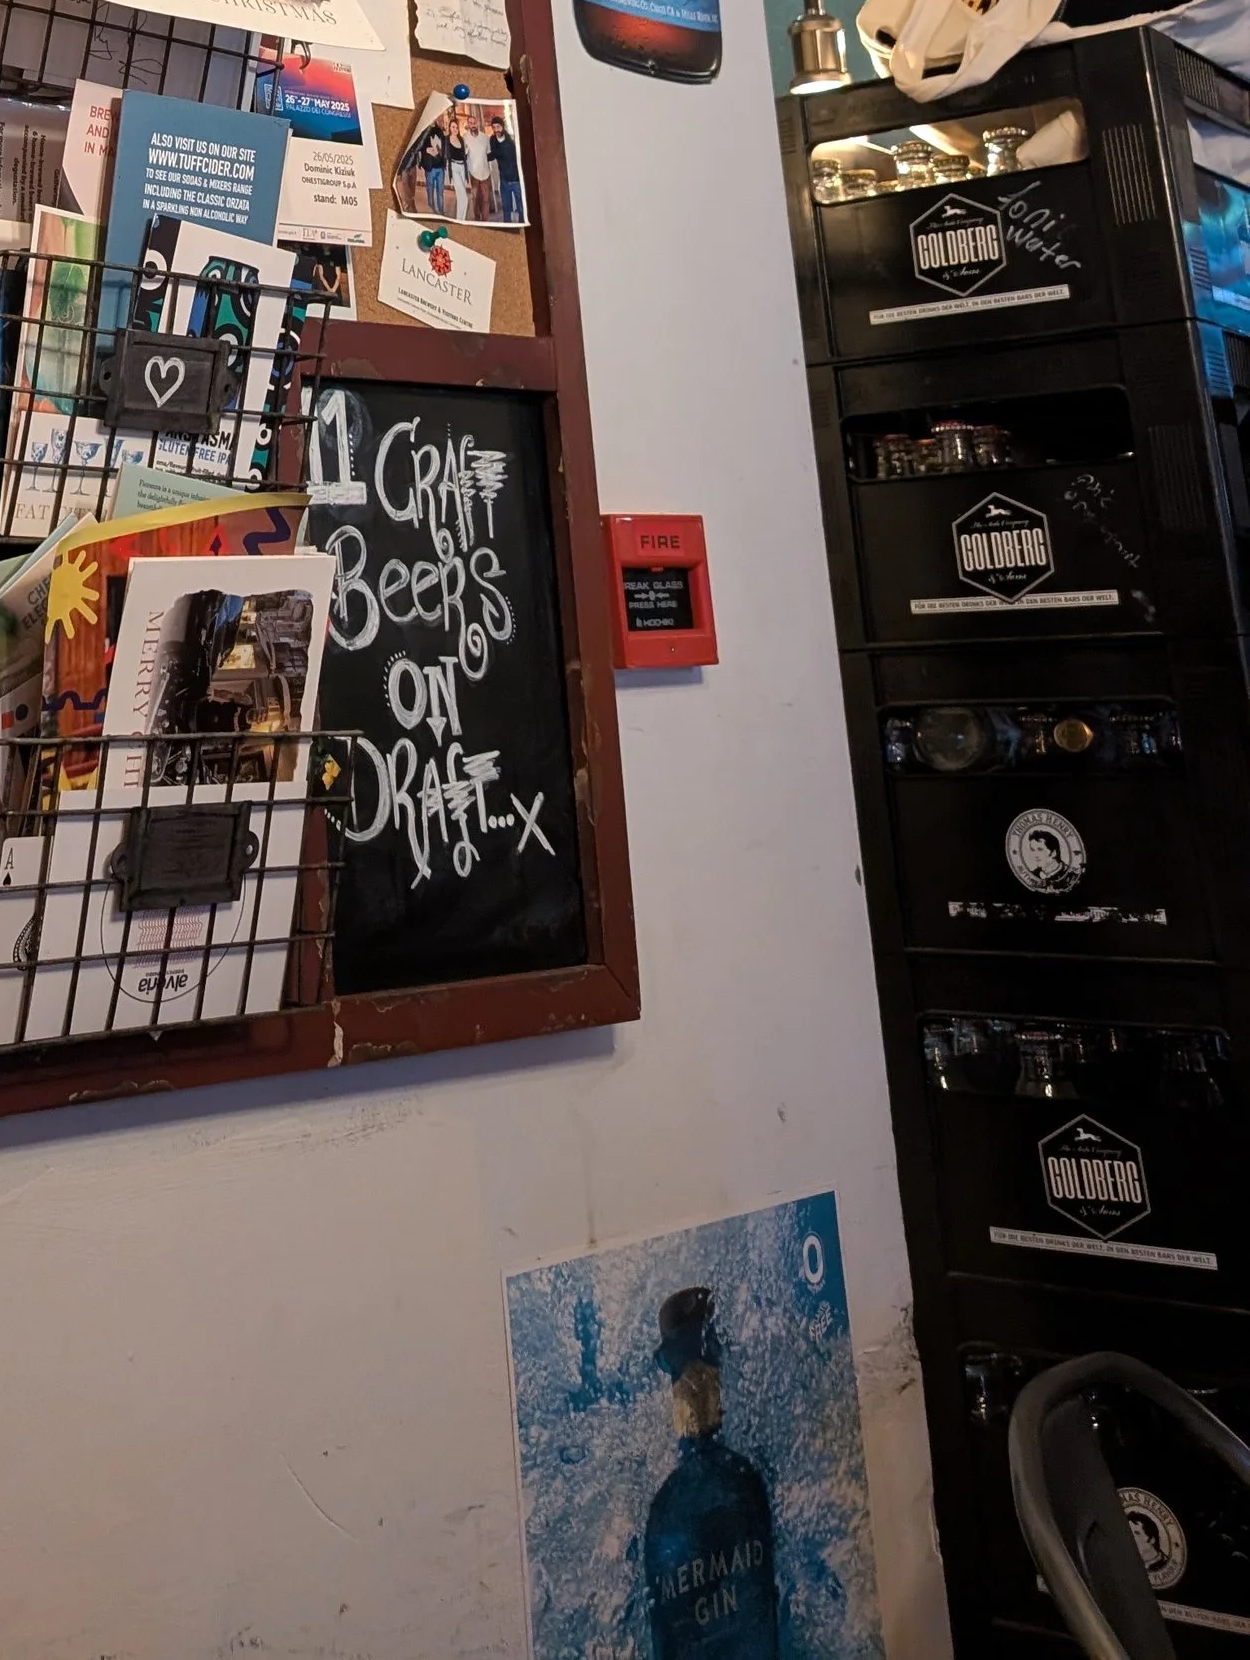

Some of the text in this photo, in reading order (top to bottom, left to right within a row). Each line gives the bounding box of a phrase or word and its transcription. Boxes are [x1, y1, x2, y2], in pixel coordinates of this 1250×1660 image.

[315, 98, 350, 112] MAY 2025
[86, 123, 109, 139] AND
[84, 141, 95, 154] IN
[151, 132, 256, 163] ALSO VISIT US ON OUR SITE
[312, 151, 354, 165] 26/05/2025
[148, 148, 255, 181] WWW.TUFFCIDER.COM
[304, 163, 332, 176] Dominic
[146, 168, 253, 195] TO SEE OUR SODAS & MIXERS RANGE
[144, 183, 250, 211] INCLUDING THE CLASSIC ORZATA
[314, 194, 358, 206] stand: M05
[143, 199, 248, 225] IN A SPARKLING NON ALCOHOLIC WAY
[917, 224, 999, 270] GOLDBERG
[402, 258, 471, 305] LANCASTER
[194, 447, 215, 462] FREE
[640, 535, 681, 549] FIRE
[960, 527, 1047, 572] GOLDBERG
[624, 580, 684, 590] REAK GLASS
[629, 601, 655, 609] PRESS
[131, 610, 164, 723] MERRY
[387, 656, 463, 747] ON
[1012, 812, 1074, 838] THOMAS HENRY
[3, 846, 15, 871] A
[138, 974, 188, 995] alvria
[1047, 1156, 1142, 1203] GOLDBERG
[654, 1539, 764, 1600] MERMAID
[694, 1586, 740, 1626] GIN
